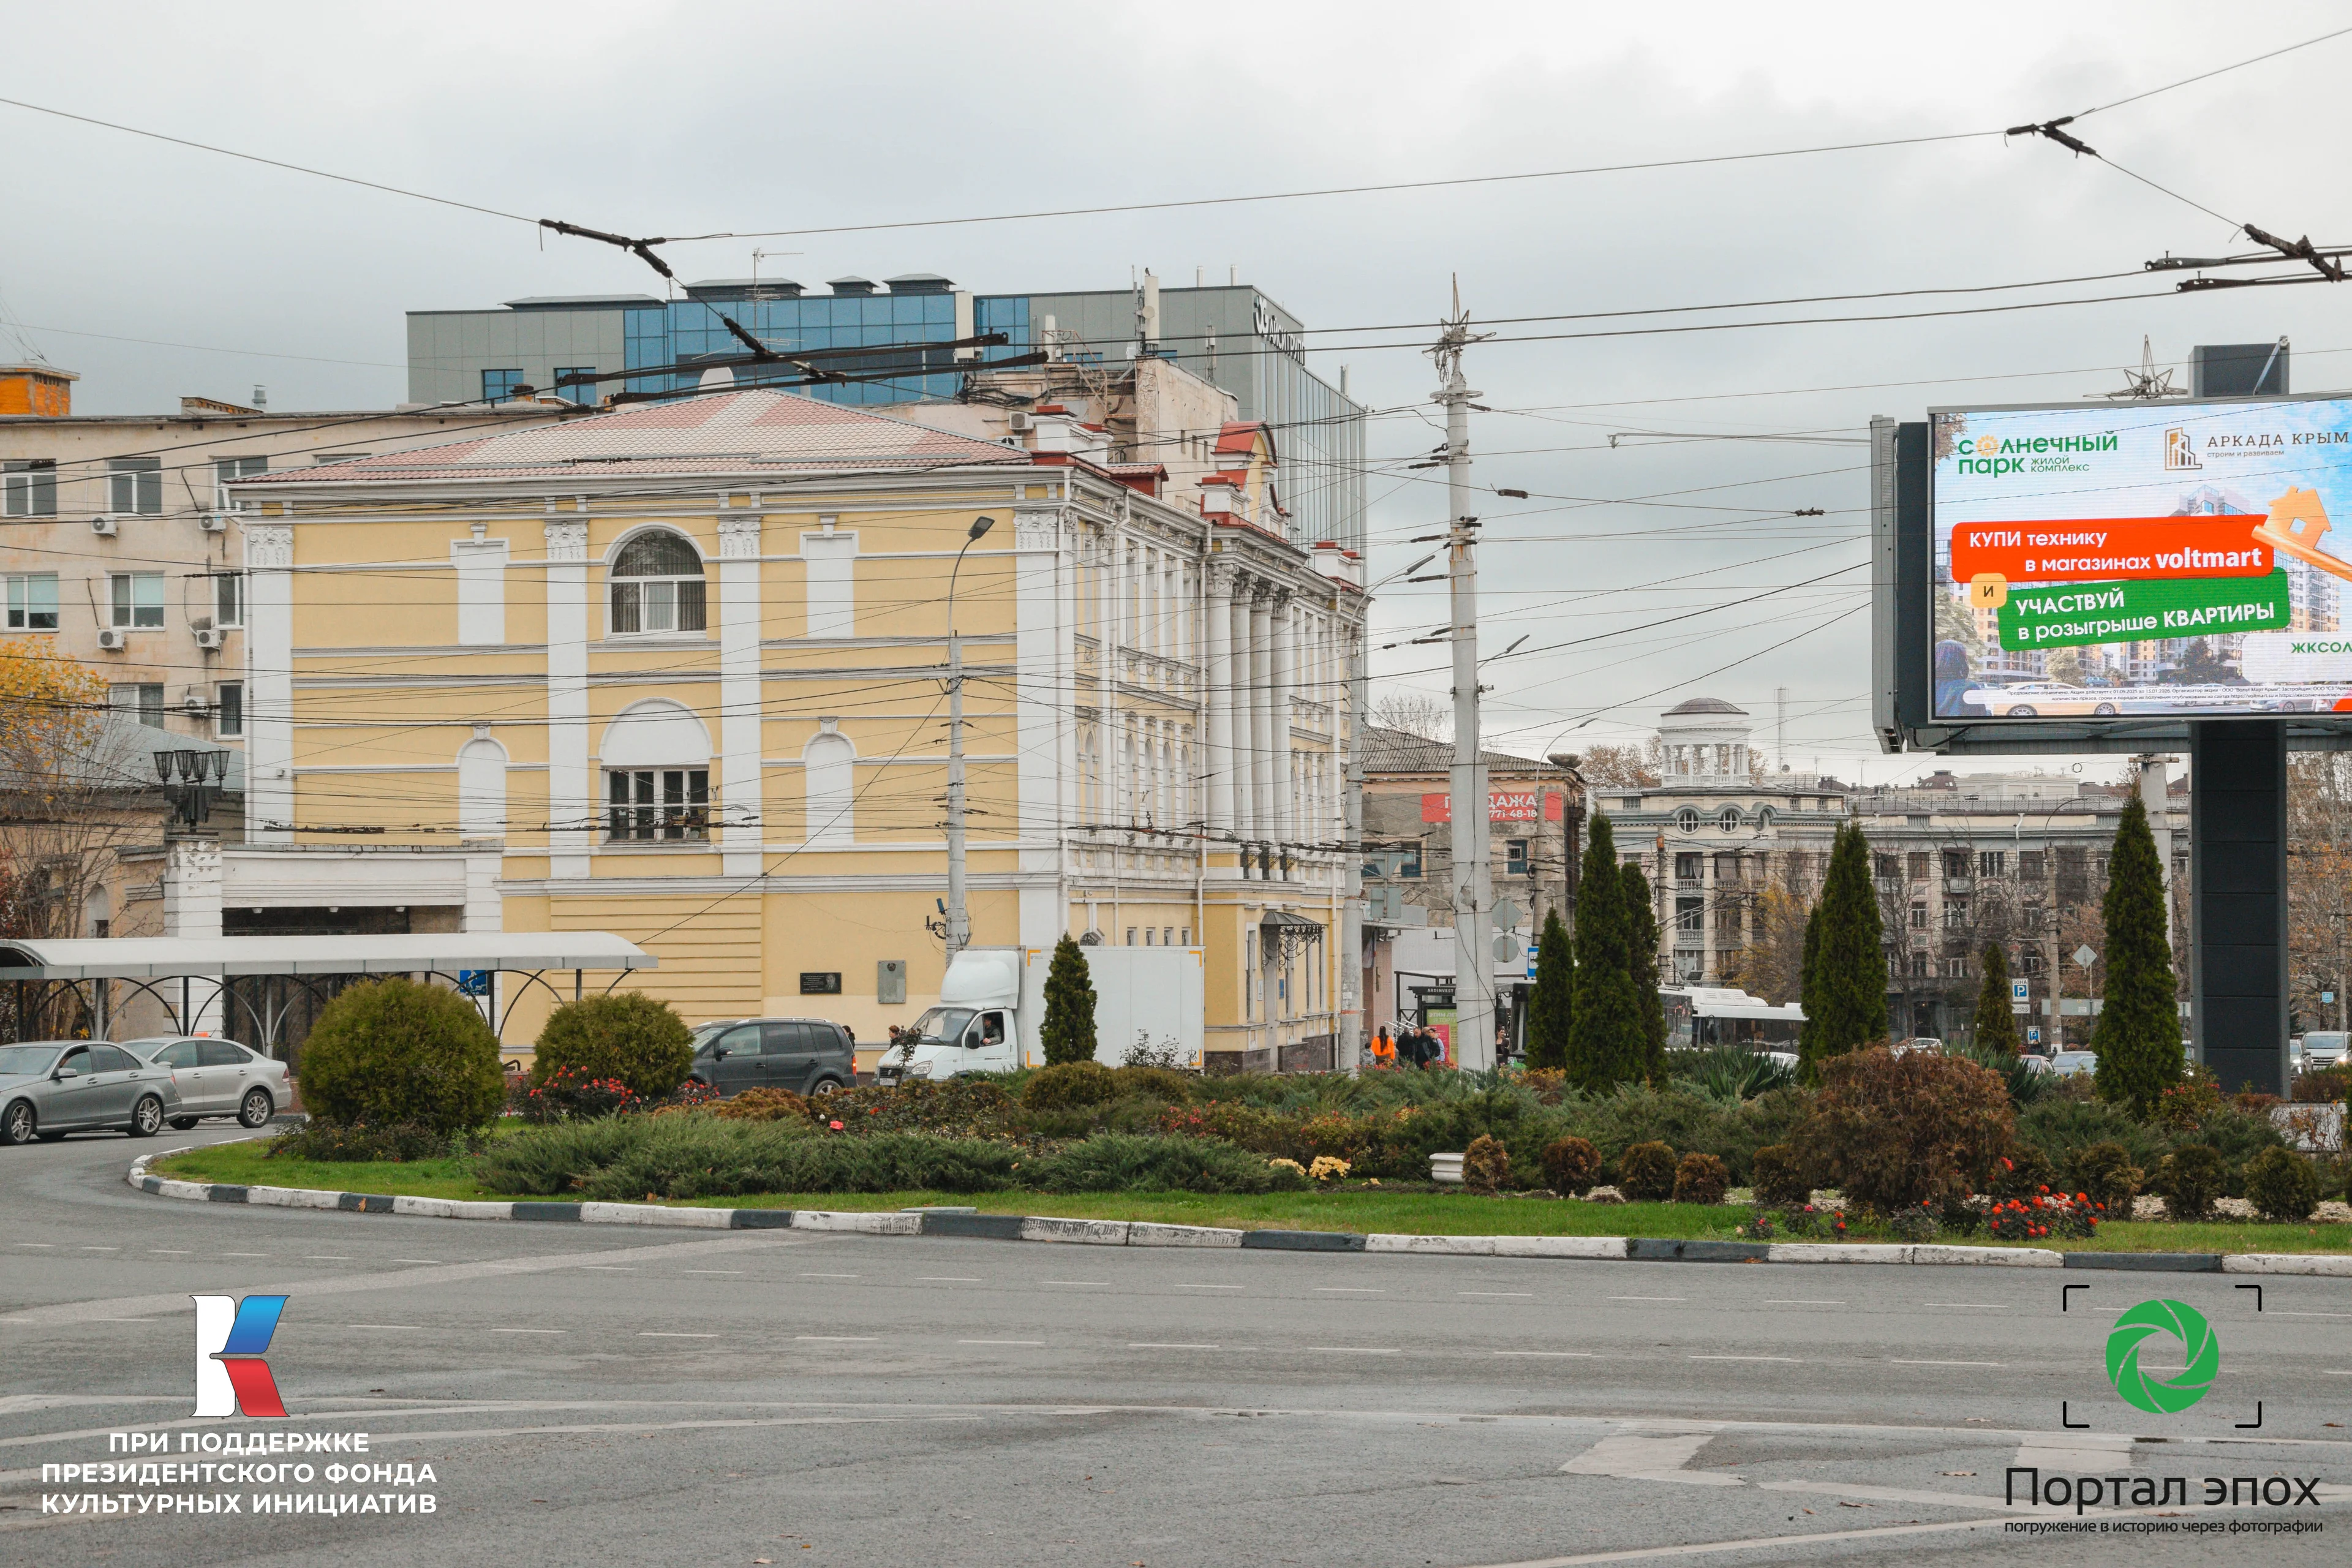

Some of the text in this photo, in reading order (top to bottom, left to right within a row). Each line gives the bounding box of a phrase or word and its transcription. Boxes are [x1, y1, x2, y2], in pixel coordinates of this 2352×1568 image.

[2207, 431, 2349, 448] АРКАДА КРЫМ
[1959, 457, 2026, 478] парк
[1969, 531, 2108, 548] КУПИ технику
[2026, 546, 2263, 571] в магазинах voltmart
[2016, 587, 2125, 616] УЧАСТВУЙ
[2018, 602, 2274, 642] в розыгрыше КВАРТИРЫ
[2017, 985, 2025, 997] P
